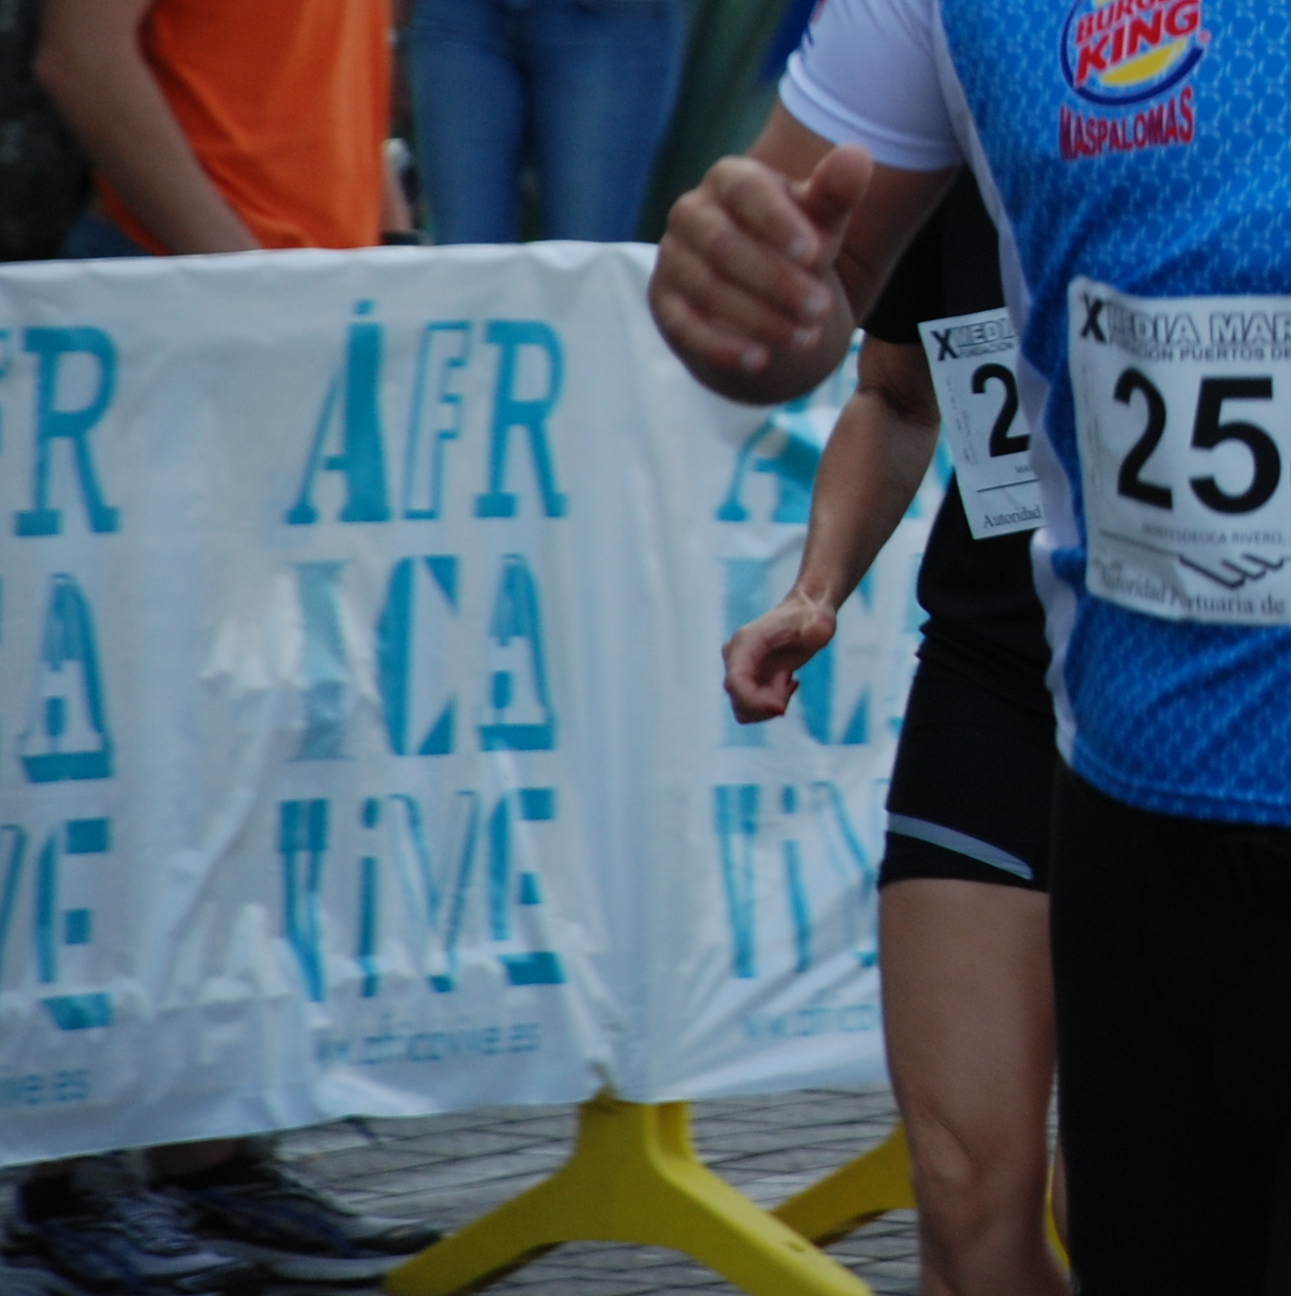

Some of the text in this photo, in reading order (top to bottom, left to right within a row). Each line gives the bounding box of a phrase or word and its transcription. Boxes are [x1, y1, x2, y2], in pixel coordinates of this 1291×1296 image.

[1058, 86, 1195, 162] MASPALOMAS
[1081, 291, 1107, 345] X
[930, 329, 959, 362] X
[1260, 593, 1285, 616] de
